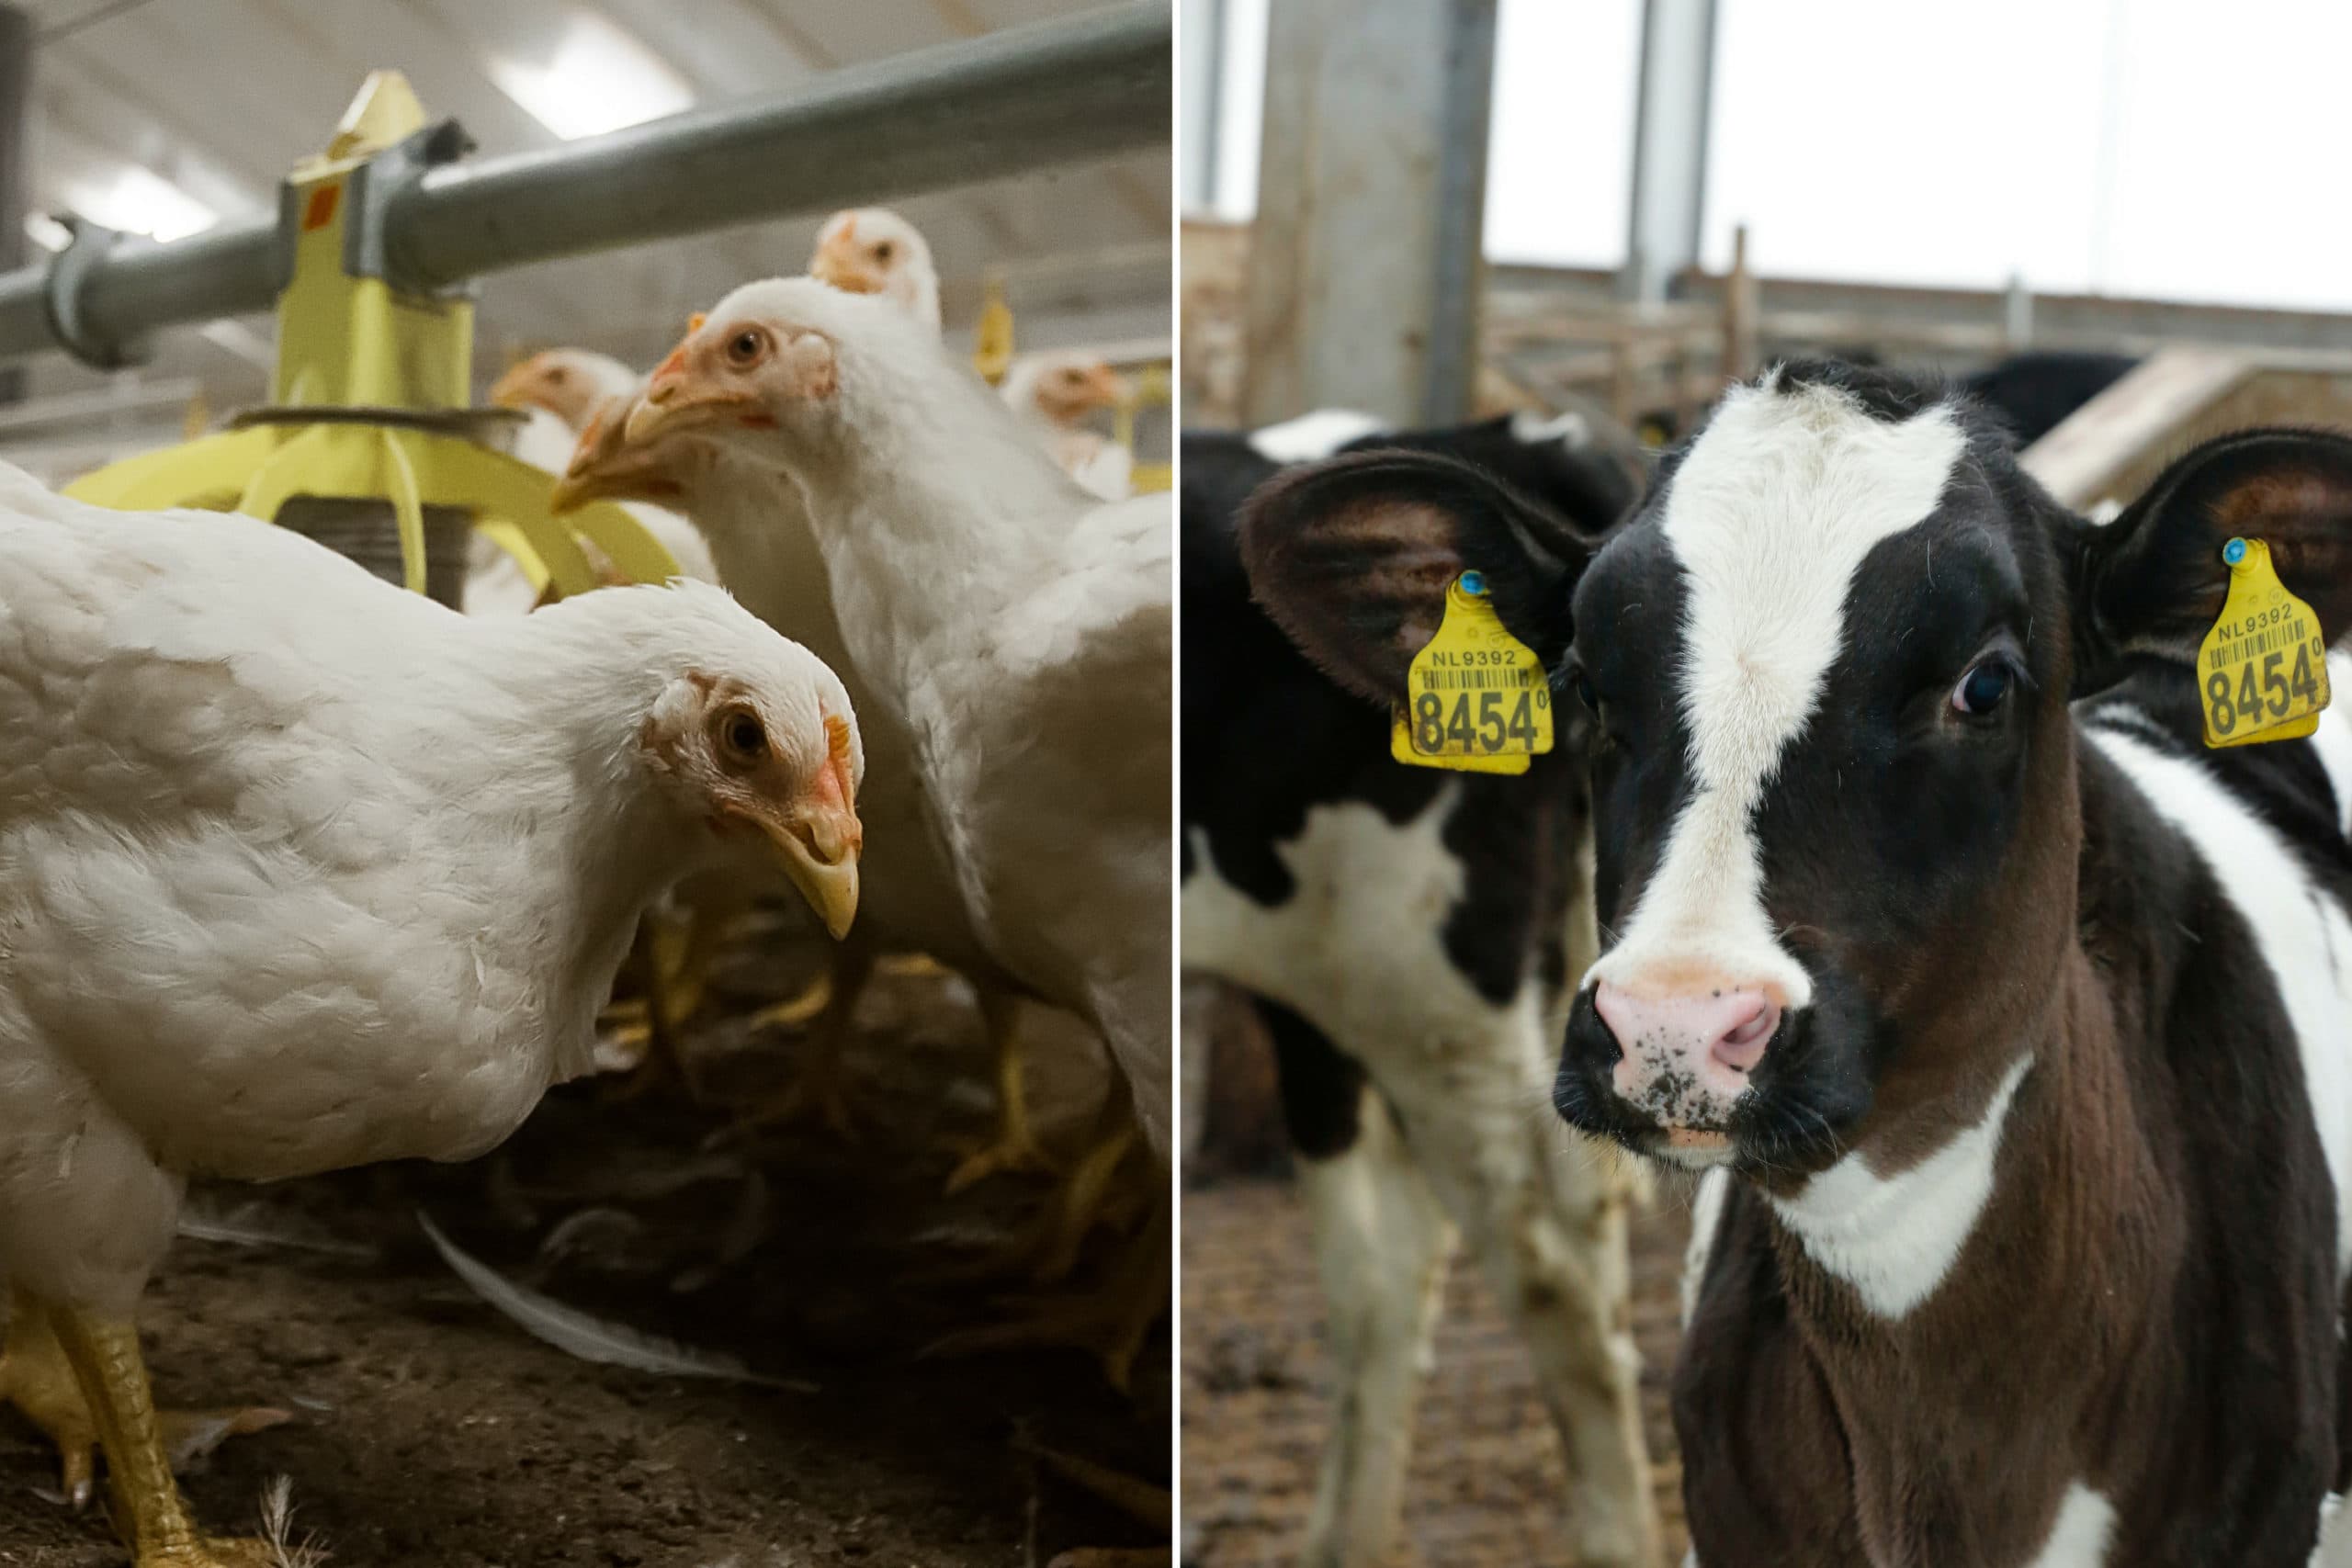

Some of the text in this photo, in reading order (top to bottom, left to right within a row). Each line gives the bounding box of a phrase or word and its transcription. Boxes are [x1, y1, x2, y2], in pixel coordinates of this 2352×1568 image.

[2219, 604, 2292, 642] NL9392
[1432, 650, 1516, 667] NL9392
[2207, 643, 2318, 735] 8454
[1416, 691, 1538, 753] 8454
